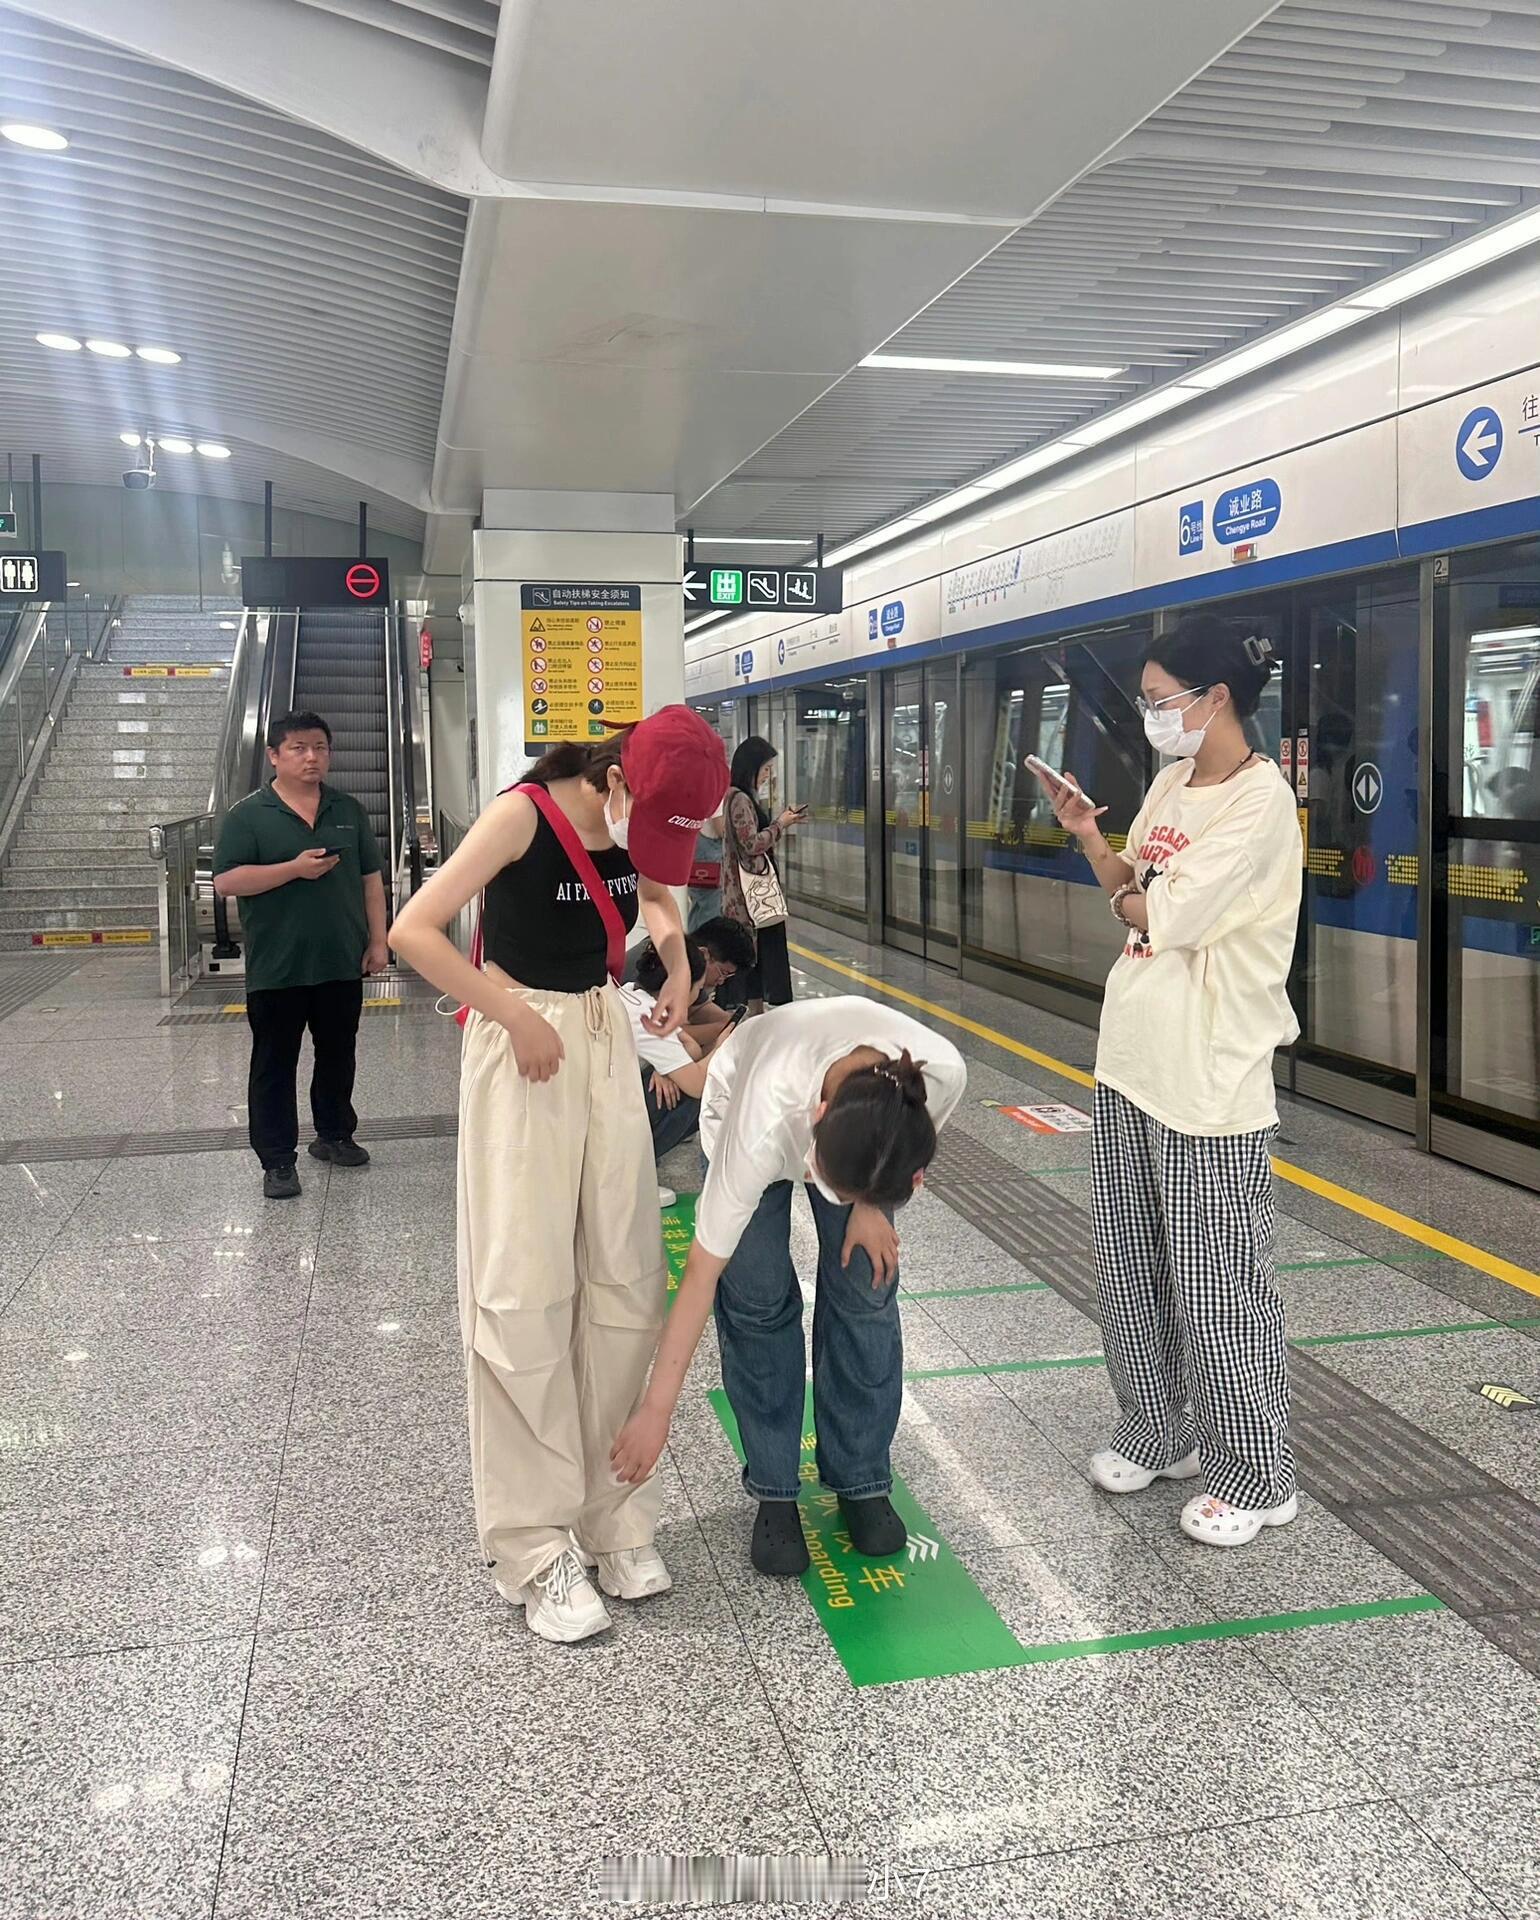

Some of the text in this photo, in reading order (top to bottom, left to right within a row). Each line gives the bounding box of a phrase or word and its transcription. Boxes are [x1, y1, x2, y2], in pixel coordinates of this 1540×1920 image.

[1522, 394, 1538, 421] 往
[1229, 488, 1263, 516] 诚业路
[1225, 516, 1266, 536] Chengye Road
[1435, 559, 1442, 575] 2
[552, 588, 630, 600] 自动扶梯安全须知
[717, 592, 735, 601] EXIT
[805, 1528, 857, 1608] boarding
